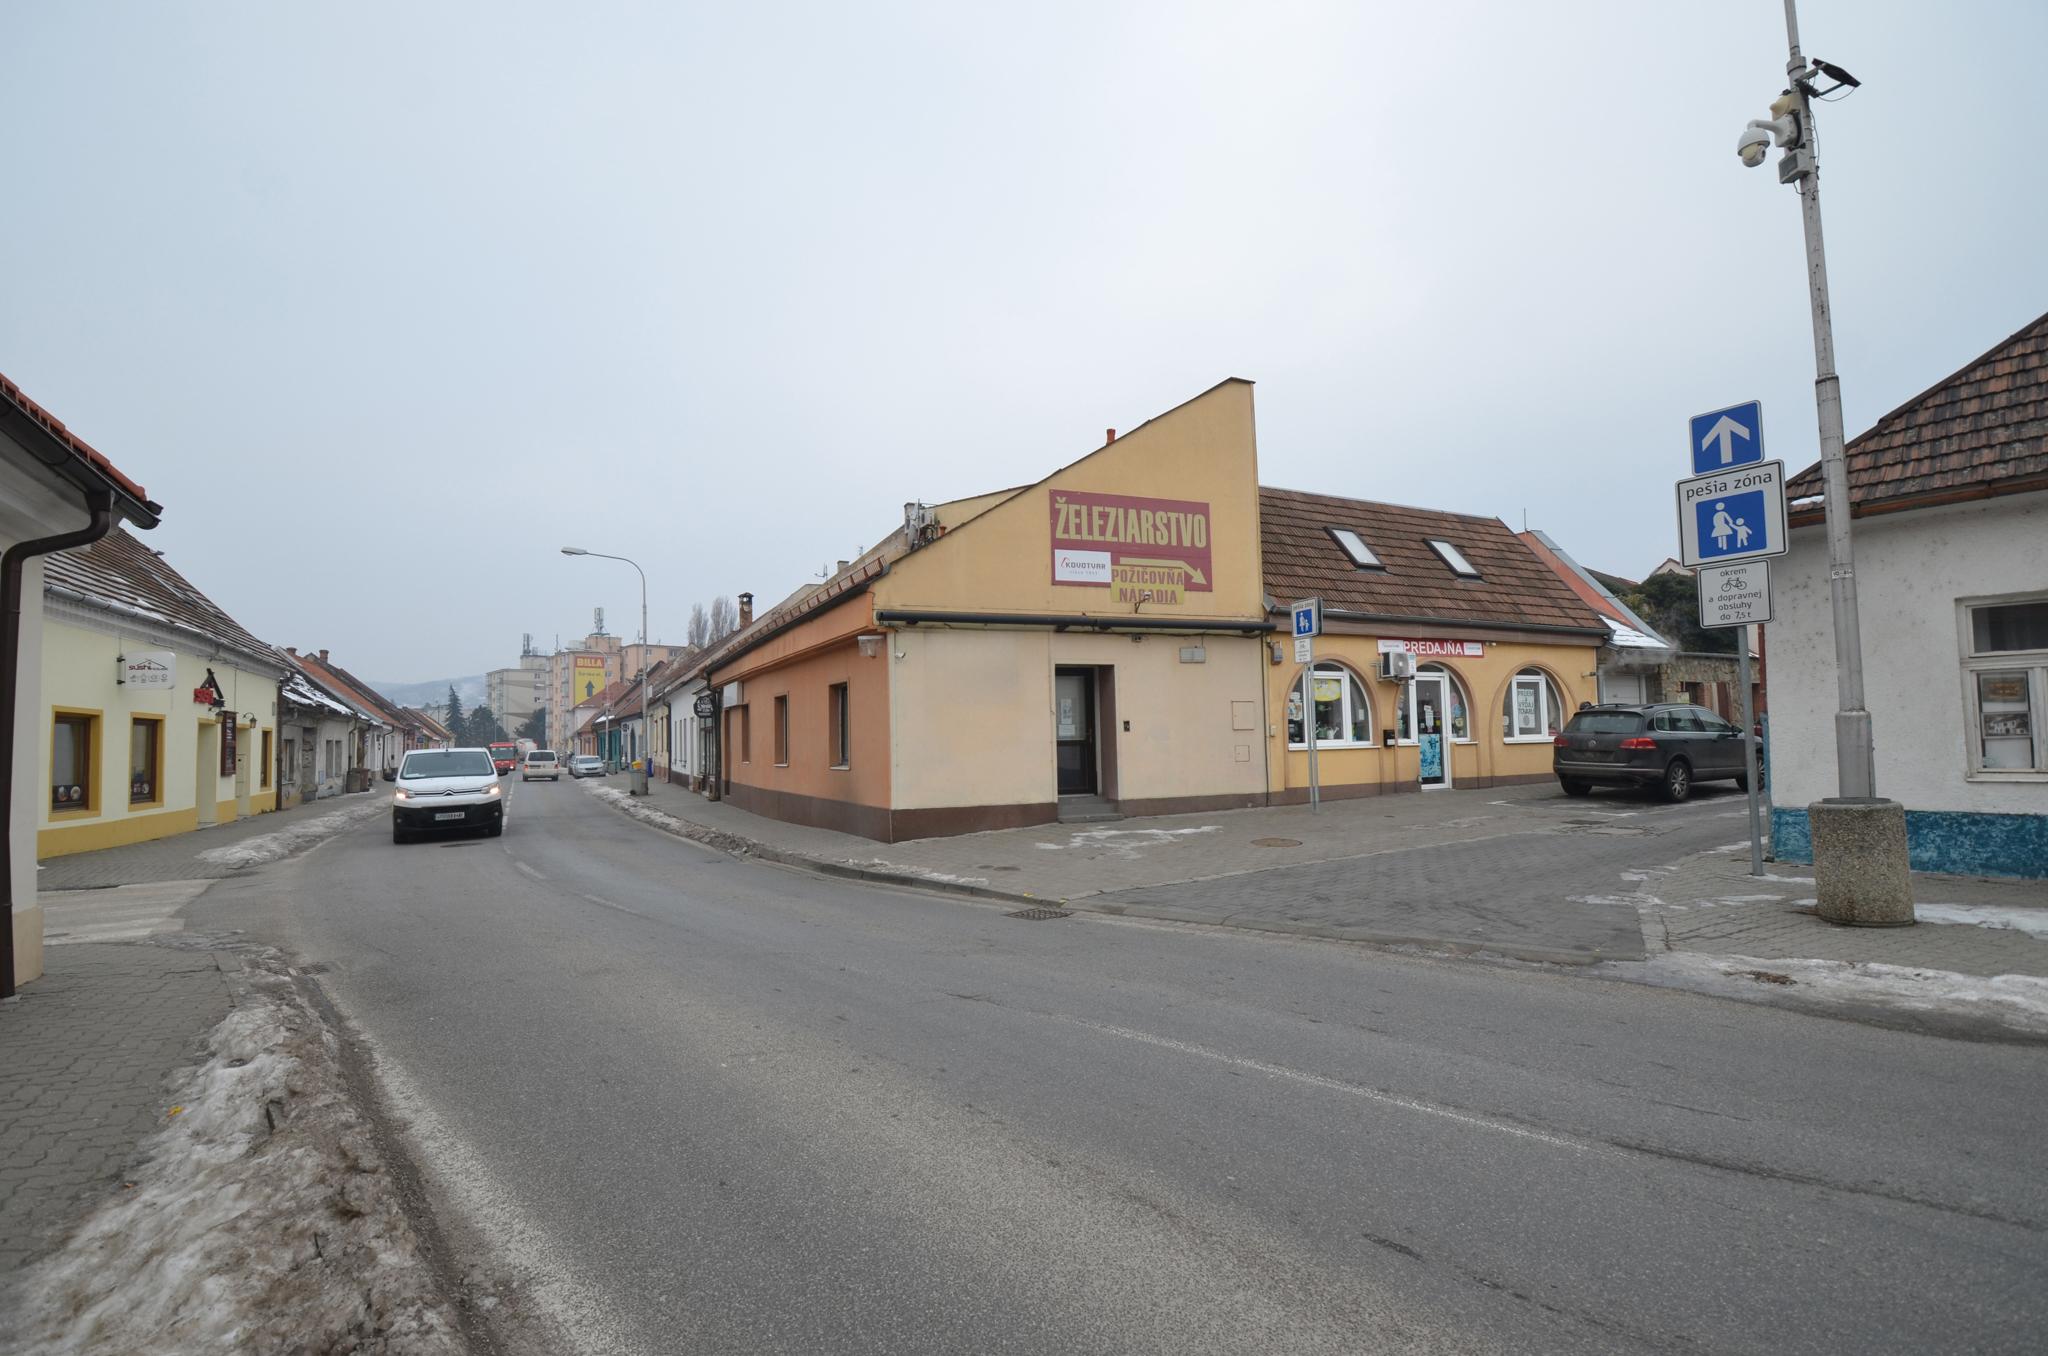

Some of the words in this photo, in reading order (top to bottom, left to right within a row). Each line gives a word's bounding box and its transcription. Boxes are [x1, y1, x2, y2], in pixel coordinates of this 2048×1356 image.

[1686, 480, 1727, 501] pešia
[1734, 472, 1772, 490] zóna
[1055, 496, 1207, 548] ŽELEZIARSTVO
[1111, 567, 1184, 586] POŽIČOVŇA
[1720, 568, 1747, 577] okrem
[1717, 590, 1762, 602] dopravnej
[1718, 601, 1752, 611] obsluhy
[1720, 613, 1731, 621] do
[1403, 640, 1464, 655] PREDAJŇA
[576, 658, 603, 667] BILLA
